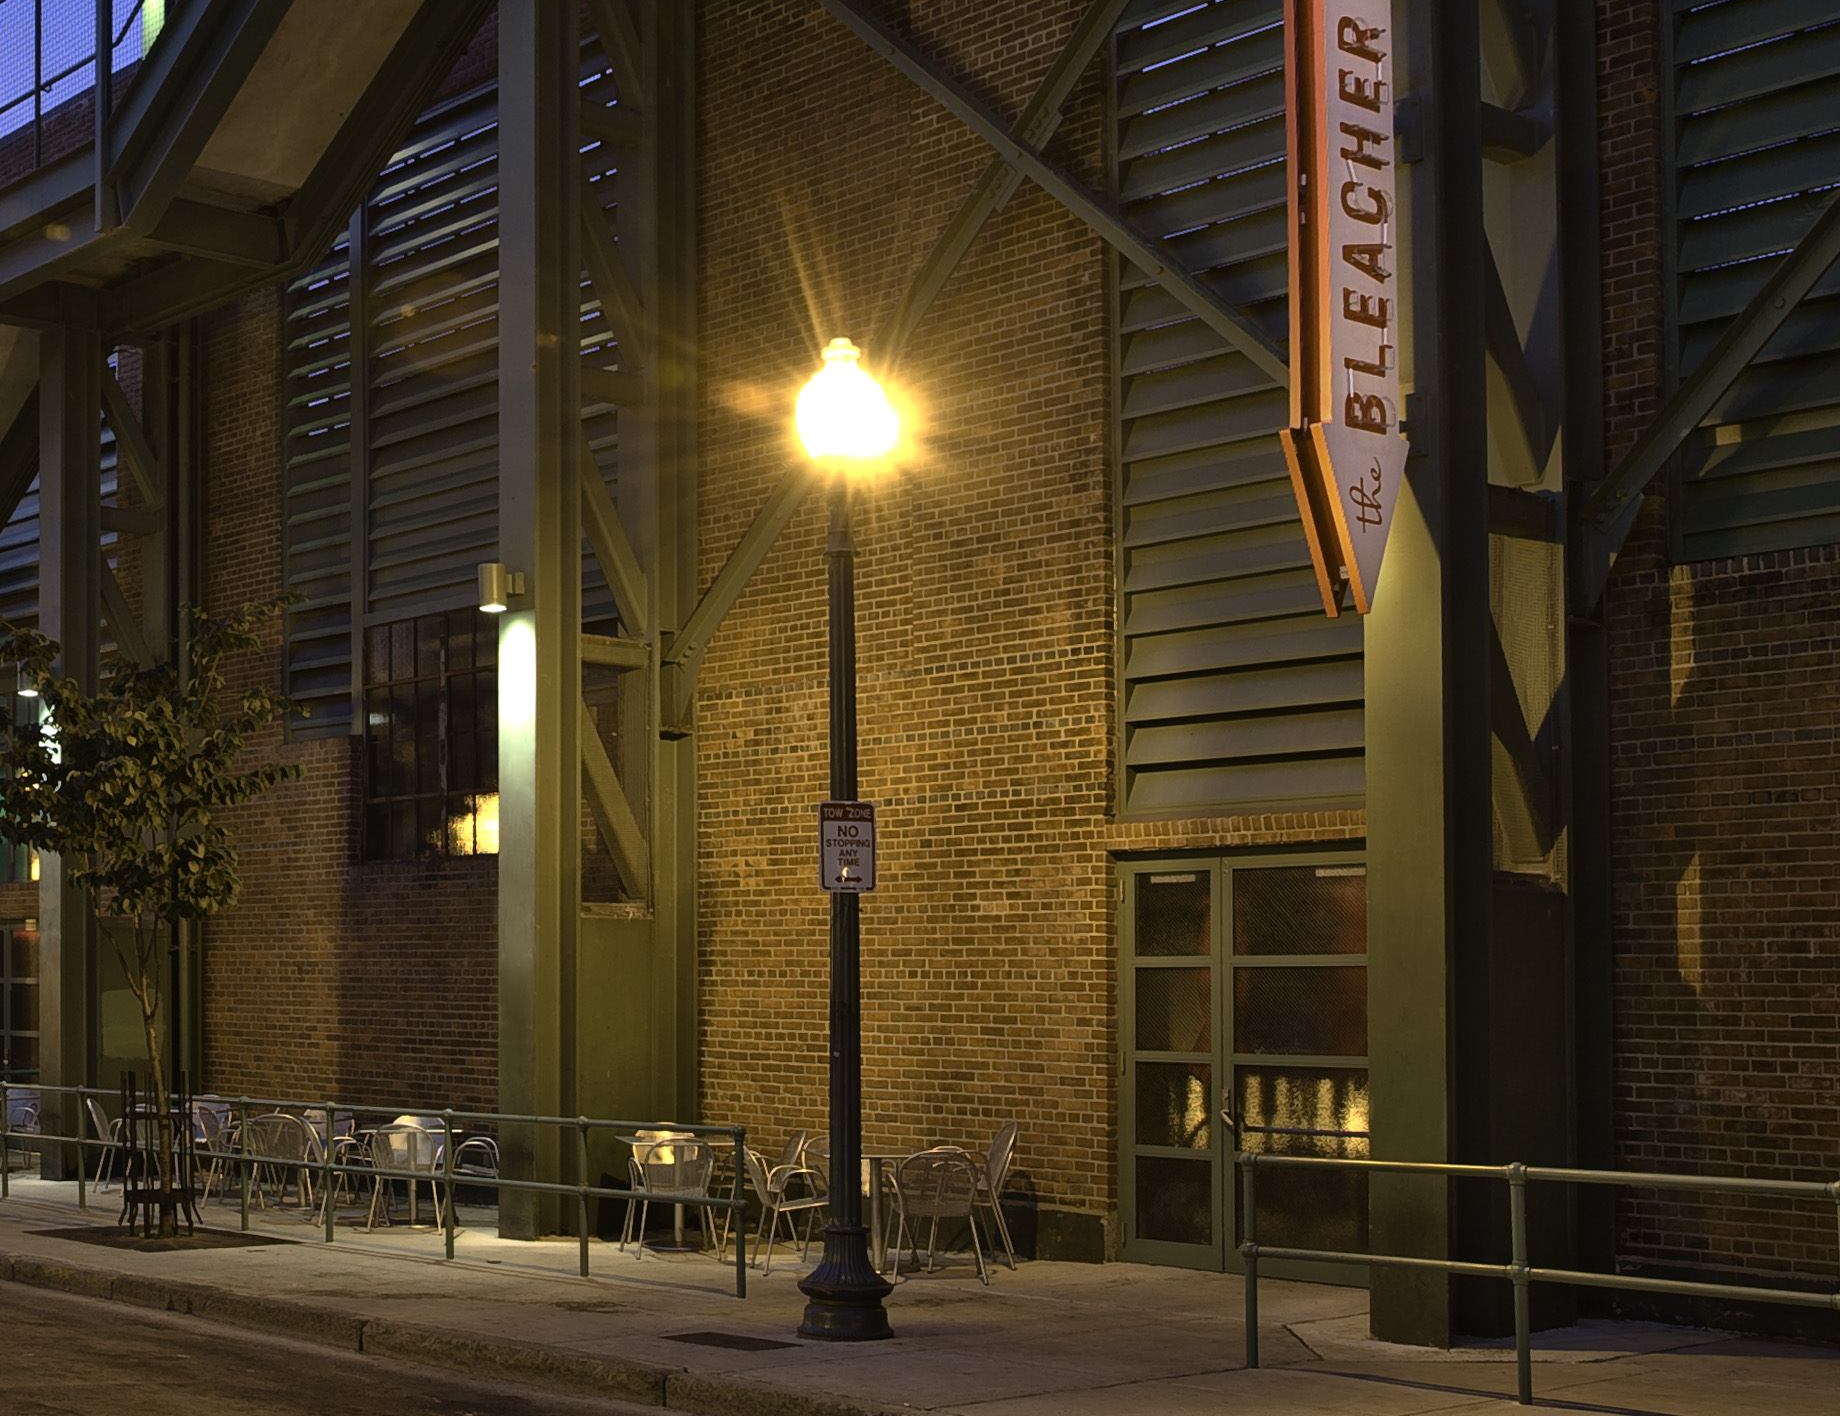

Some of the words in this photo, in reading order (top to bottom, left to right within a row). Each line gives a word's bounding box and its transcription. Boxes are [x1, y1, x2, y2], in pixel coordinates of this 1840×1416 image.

[1337, 16, 1391, 436] BLEACHER
[1349, 456, 1383, 534] the
[823, 807, 844, 818] TOW
[848, 808, 872, 819] ZONE
[837, 825, 859, 838] NO
[825, 838, 871, 849] STOPPING
[838, 849, 859, 858] ANY
[837, 857, 860, 867] TIME
